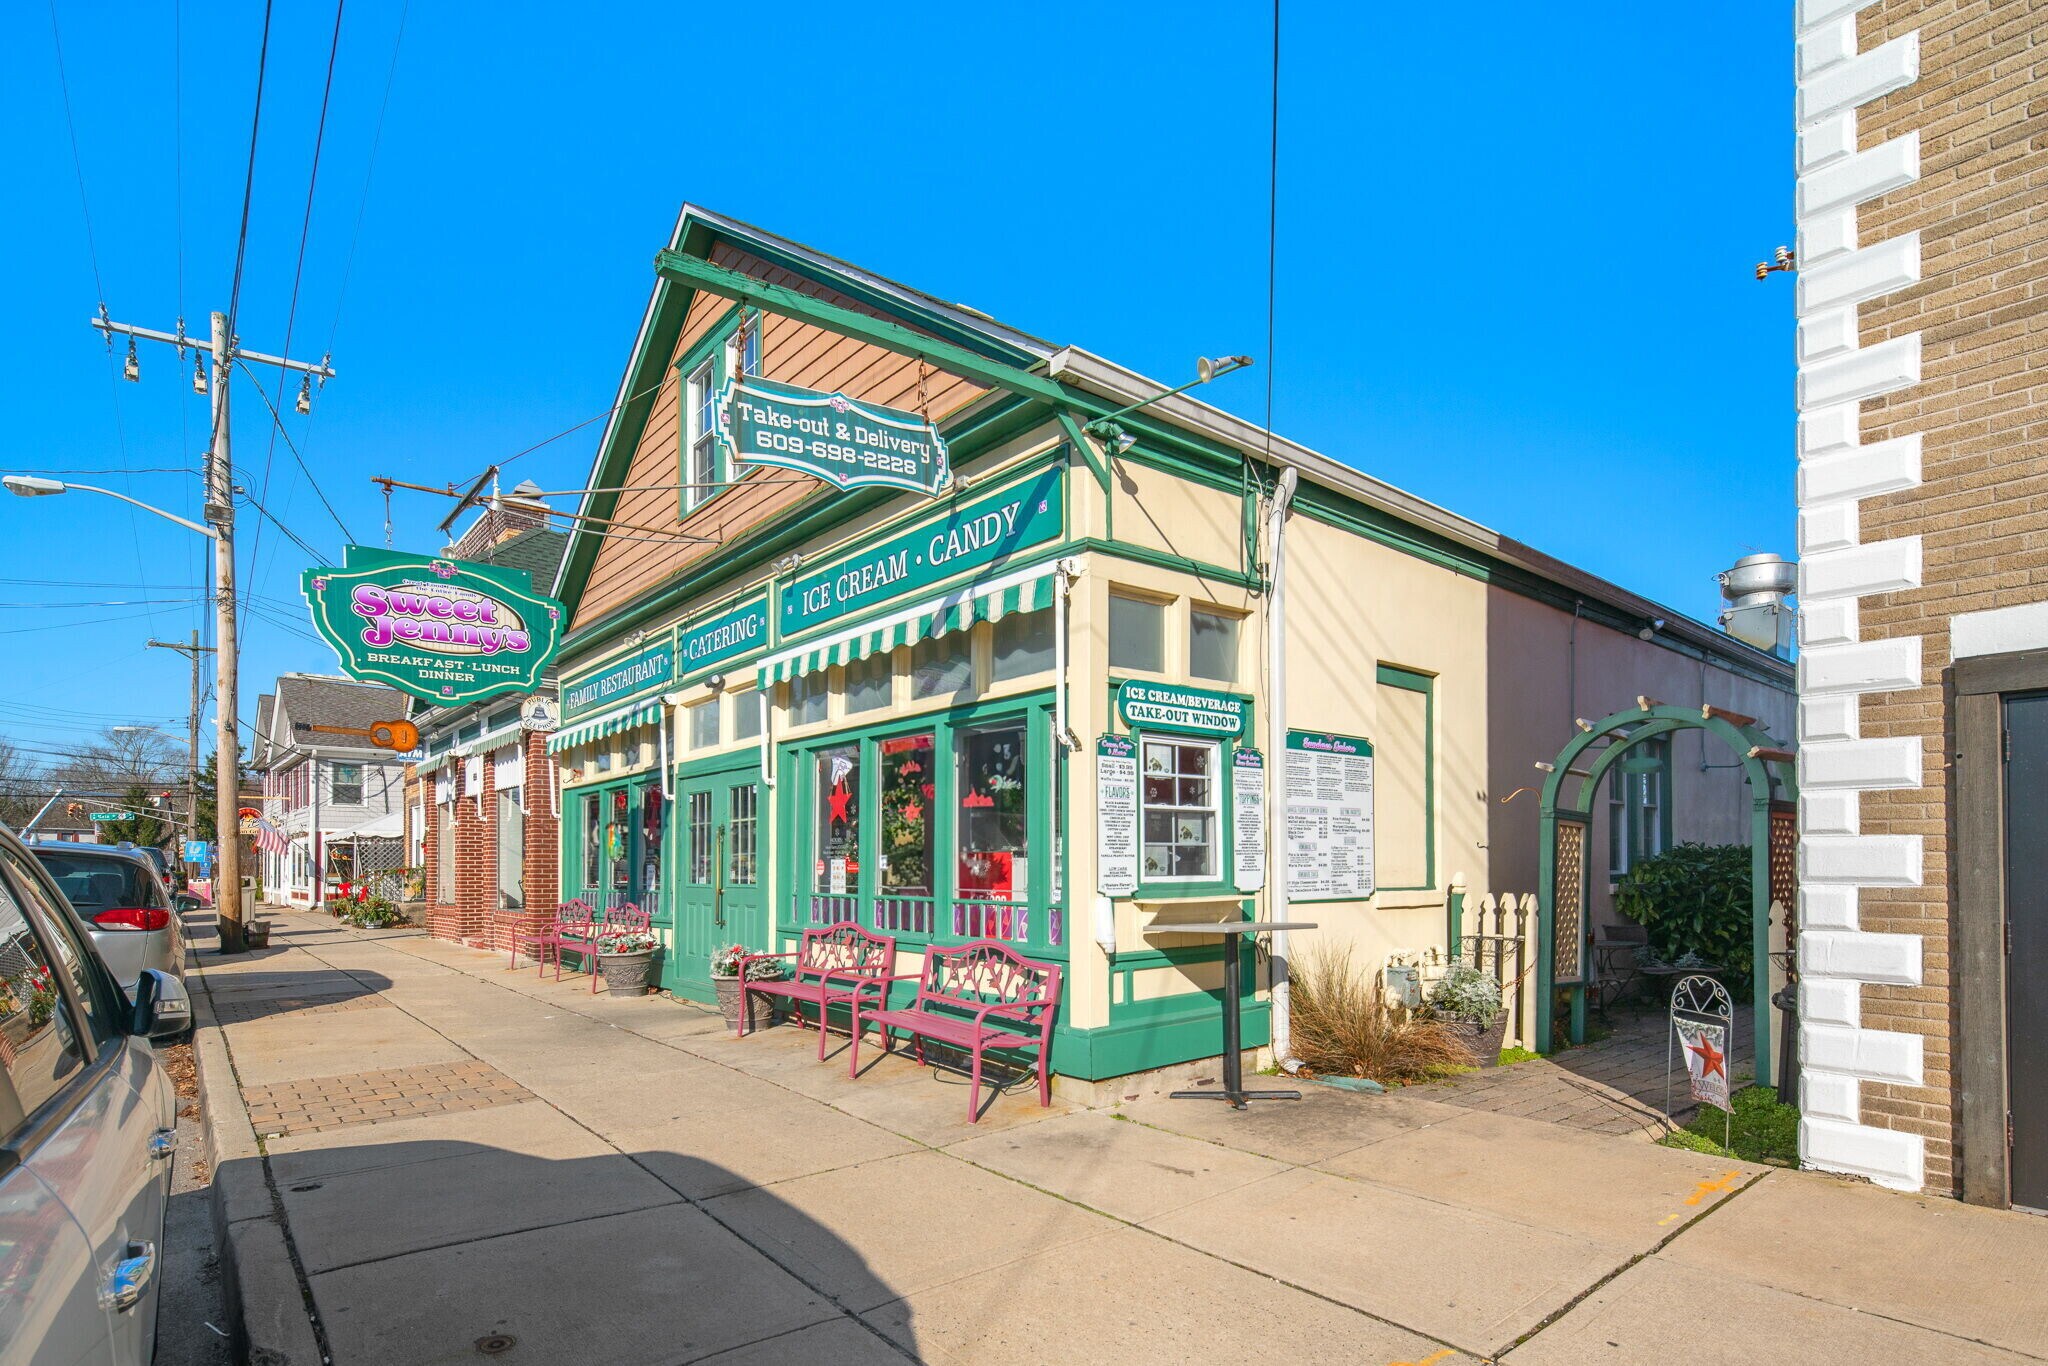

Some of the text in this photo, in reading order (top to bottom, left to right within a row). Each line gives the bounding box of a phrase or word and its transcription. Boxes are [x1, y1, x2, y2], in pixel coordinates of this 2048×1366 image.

[738, 401, 930, 464] Take-out & Delivery
[756, 430, 917, 475] 609-698-2228
[801, 501, 1022, 617] ICE CREAM CANDY
[353, 584, 498, 625] Sweet
[362, 615, 530, 653] Jenny's
[688, 613, 758, 660] CATERING
[367, 653, 521, 675] BREAKFAST LUNCH
[418, 668, 476, 682] DINNER
[569, 653, 665, 710] FAMILY RESTAURANT
[526, 697, 553, 707] PUBLIC
[1125, 686, 1241, 714] ICE CREAM/BEVERAGE
[1129, 704, 1238, 729] TAKE-OUT WINDOW
[523, 714, 557, 730] TELEPHONE
[1105, 786, 1130, 799] FLAVORS
